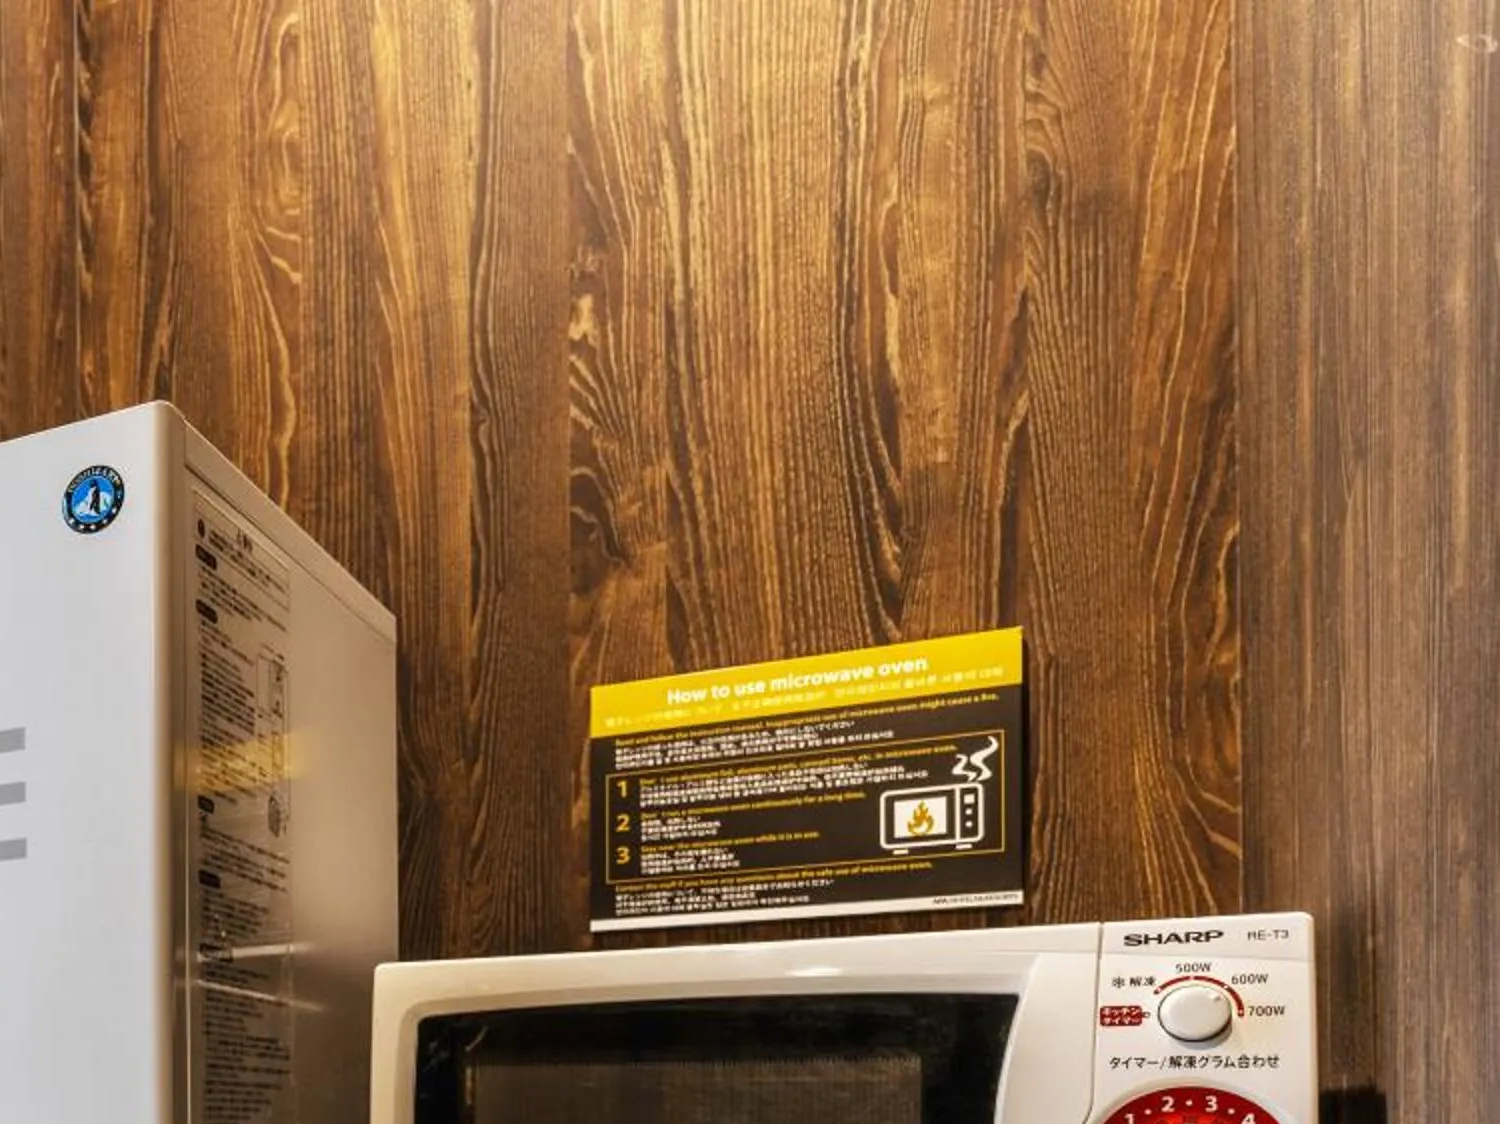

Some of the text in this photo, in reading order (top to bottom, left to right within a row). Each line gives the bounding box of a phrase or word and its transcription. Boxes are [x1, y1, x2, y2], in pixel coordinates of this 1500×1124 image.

[667, 687, 708, 704] How
[711, 685, 730, 699] to
[734, 680, 765, 697] use
[771, 664, 874, 691] microwave
[878, 657, 928, 676] oven
[616, 780, 627, 798] 1
[616, 813, 630, 832] 2
[616, 846, 630, 865] 3
[1123, 929, 1224, 947] SHARP
[1175, 962, 1212, 974] 500W
[1129, 977, 1157, 988] 解凍
[1231, 973, 1269, 985] 600W
[1249, 1005, 1286, 1017] 700W
[1161, 1096, 1175, 1112] 2
[1205, 1095, 1218, 1112] 3
